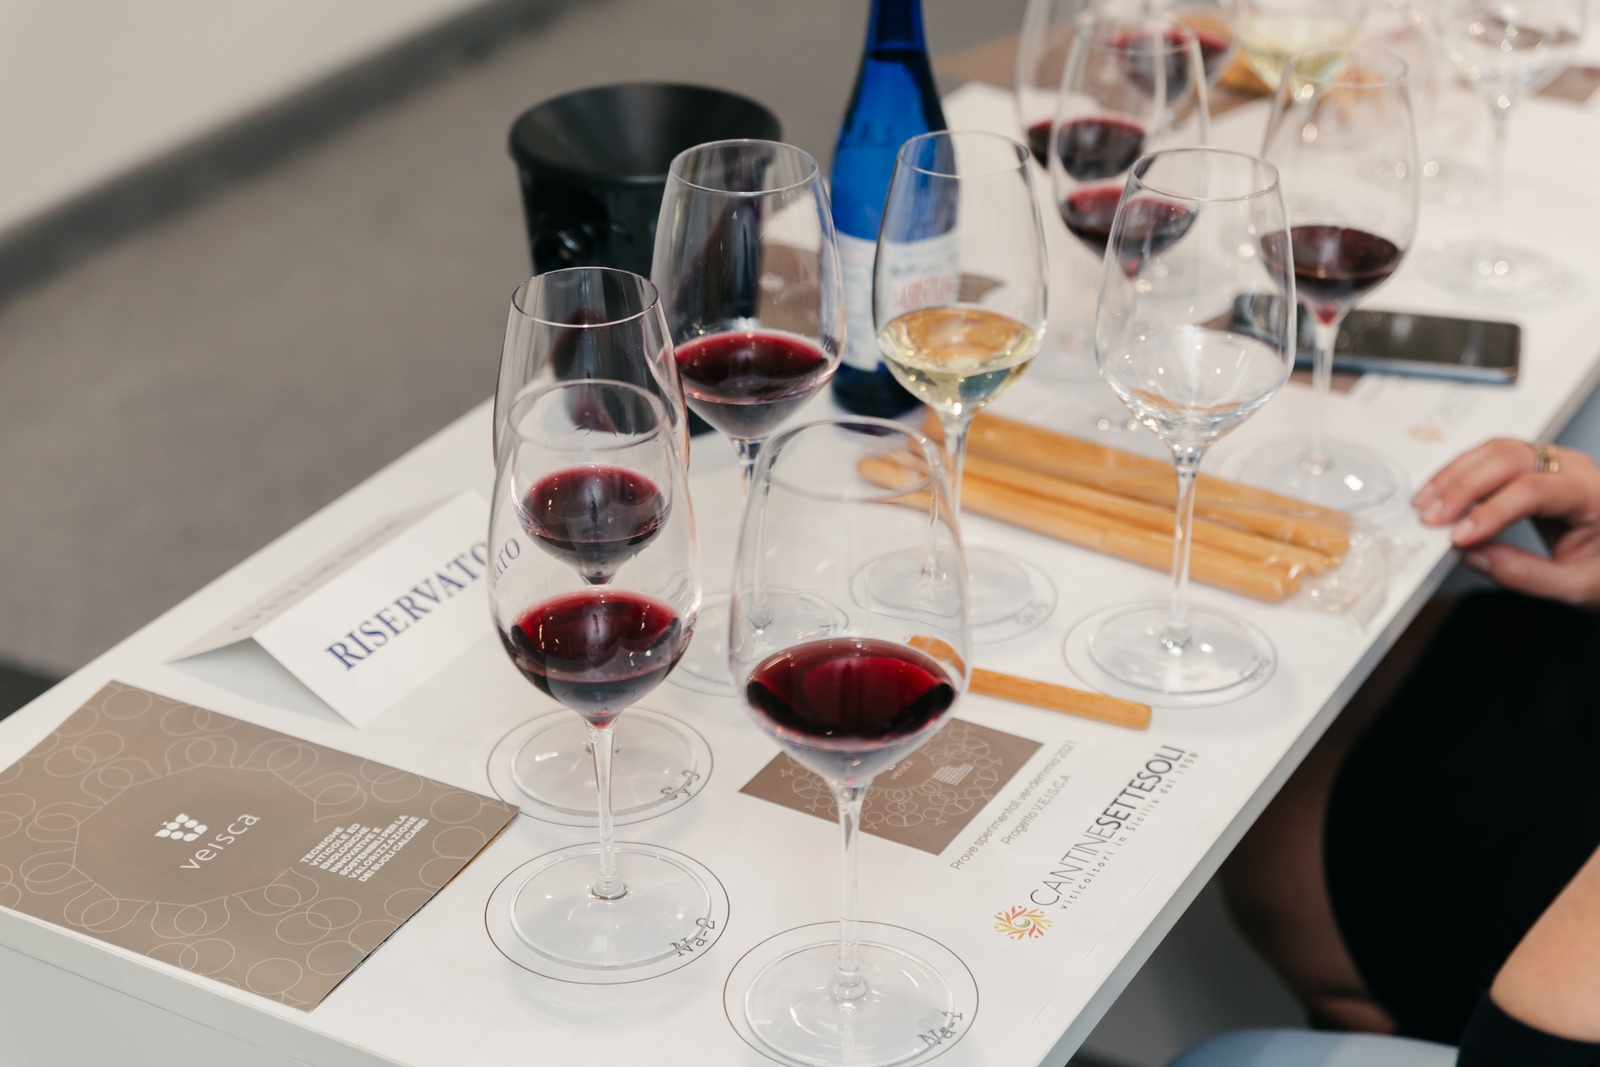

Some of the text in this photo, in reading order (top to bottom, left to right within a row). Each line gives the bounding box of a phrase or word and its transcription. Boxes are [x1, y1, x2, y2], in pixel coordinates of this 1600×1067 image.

[950, 740, 1078, 870] Prove sperimentali vendemmia 2021
[1001, 811, 1038, 844] Progetto
[1030, 745, 1187, 906] CANTINESETTESOLI
[1060, 753, 1199, 910] viticoltori in Sicilia dal 1958
[180, 814, 260, 869] veisca
[300, 827, 344, 863] TECNICHE
[309, 823, 360, 866] VITICOLE ED
[319, 826, 371, 870] ENOLOGICHE
[329, 833, 376, 873] INNOVATIVE
[339, 815, 408, 876] SOSTENIBILI PER LA
[348, 816, 419, 878] VALORIZZAZIONE
[358, 818, 429, 882] DEI SUOLI CALCAREI
